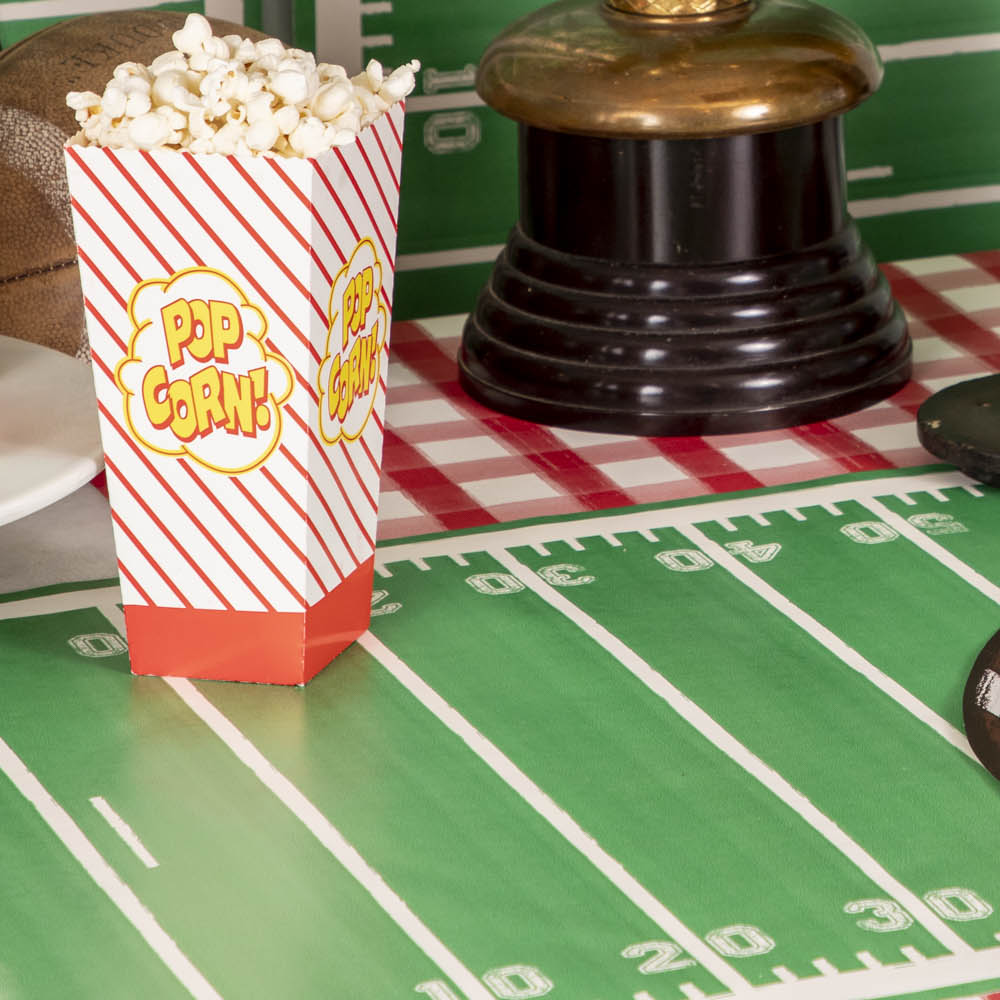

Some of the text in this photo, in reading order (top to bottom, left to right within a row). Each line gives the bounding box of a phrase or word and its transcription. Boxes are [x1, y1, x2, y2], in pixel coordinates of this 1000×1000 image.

[161, 297, 243, 370] POP
[342, 265, 374, 351] POP
[142, 365, 271, 443] CORN!
[328, 321, 380, 423] CORN!
